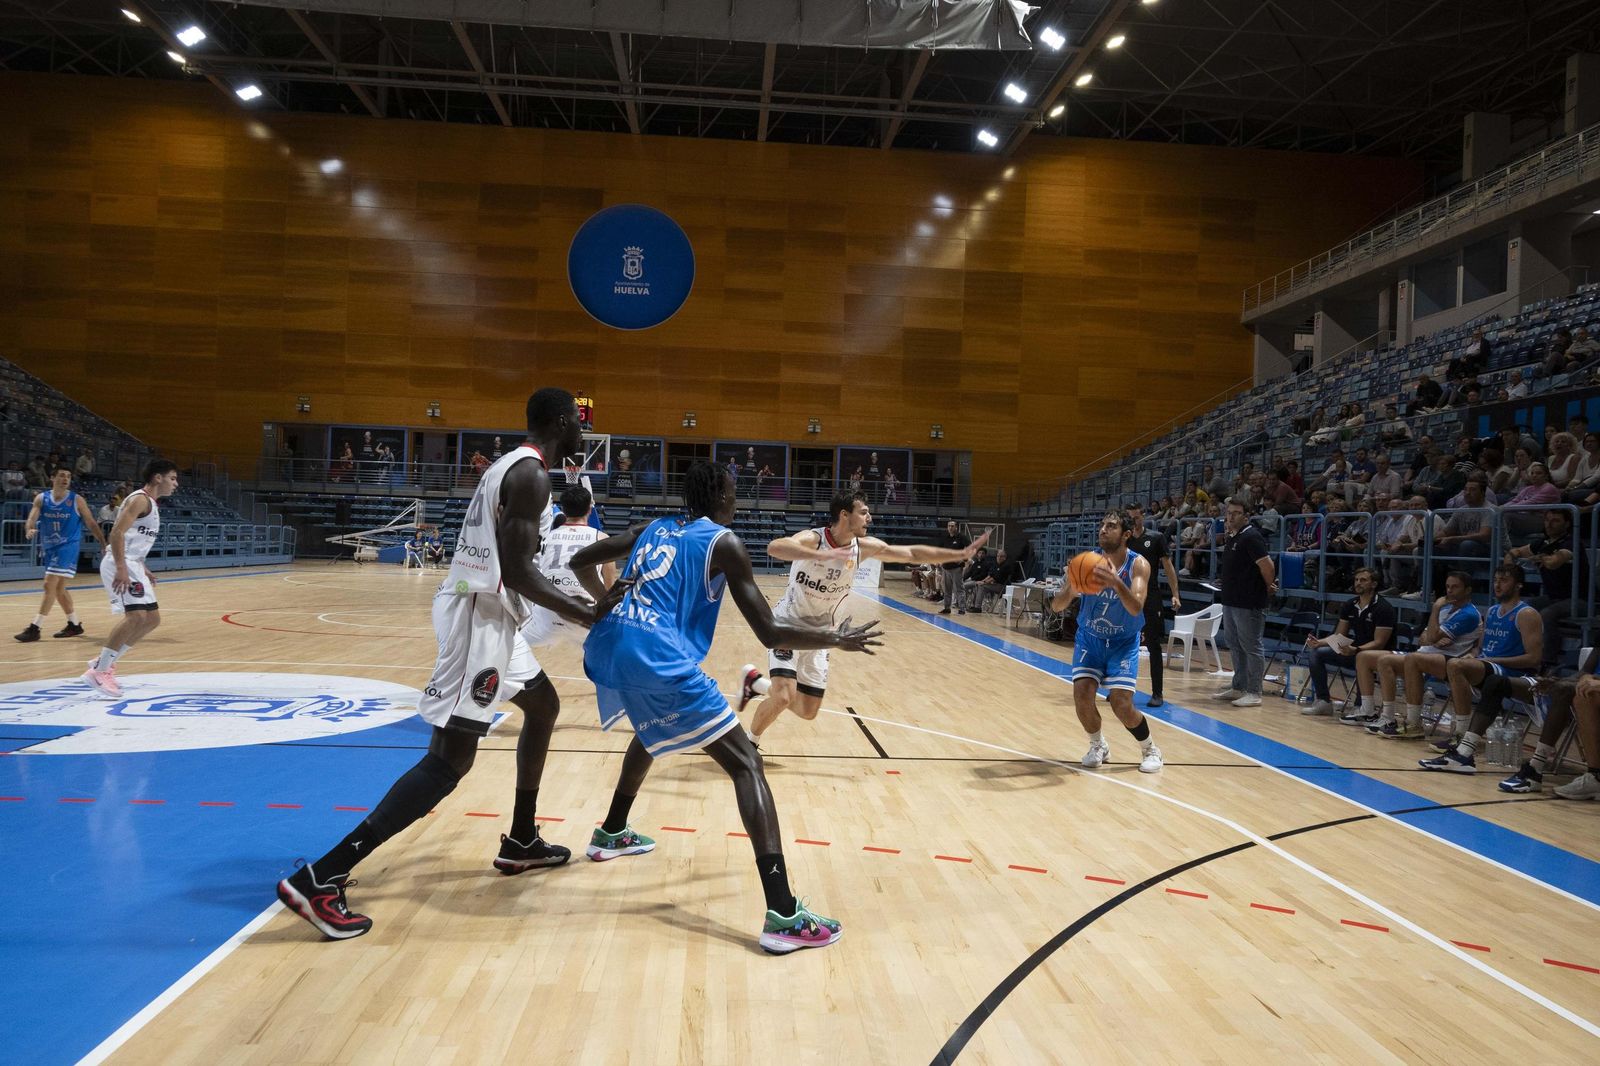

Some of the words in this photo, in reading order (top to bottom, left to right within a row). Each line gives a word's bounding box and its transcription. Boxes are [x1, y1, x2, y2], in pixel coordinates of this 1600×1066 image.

[614, 286, 650, 295] HUELVA
[552, 533, 592, 541] OLAIZOLA
[632, 542, 677, 606] 12
[825, 568, 842, 581] 33
[1102, 602, 1110, 616] 7
[1079, 649, 1088, 663] 7
